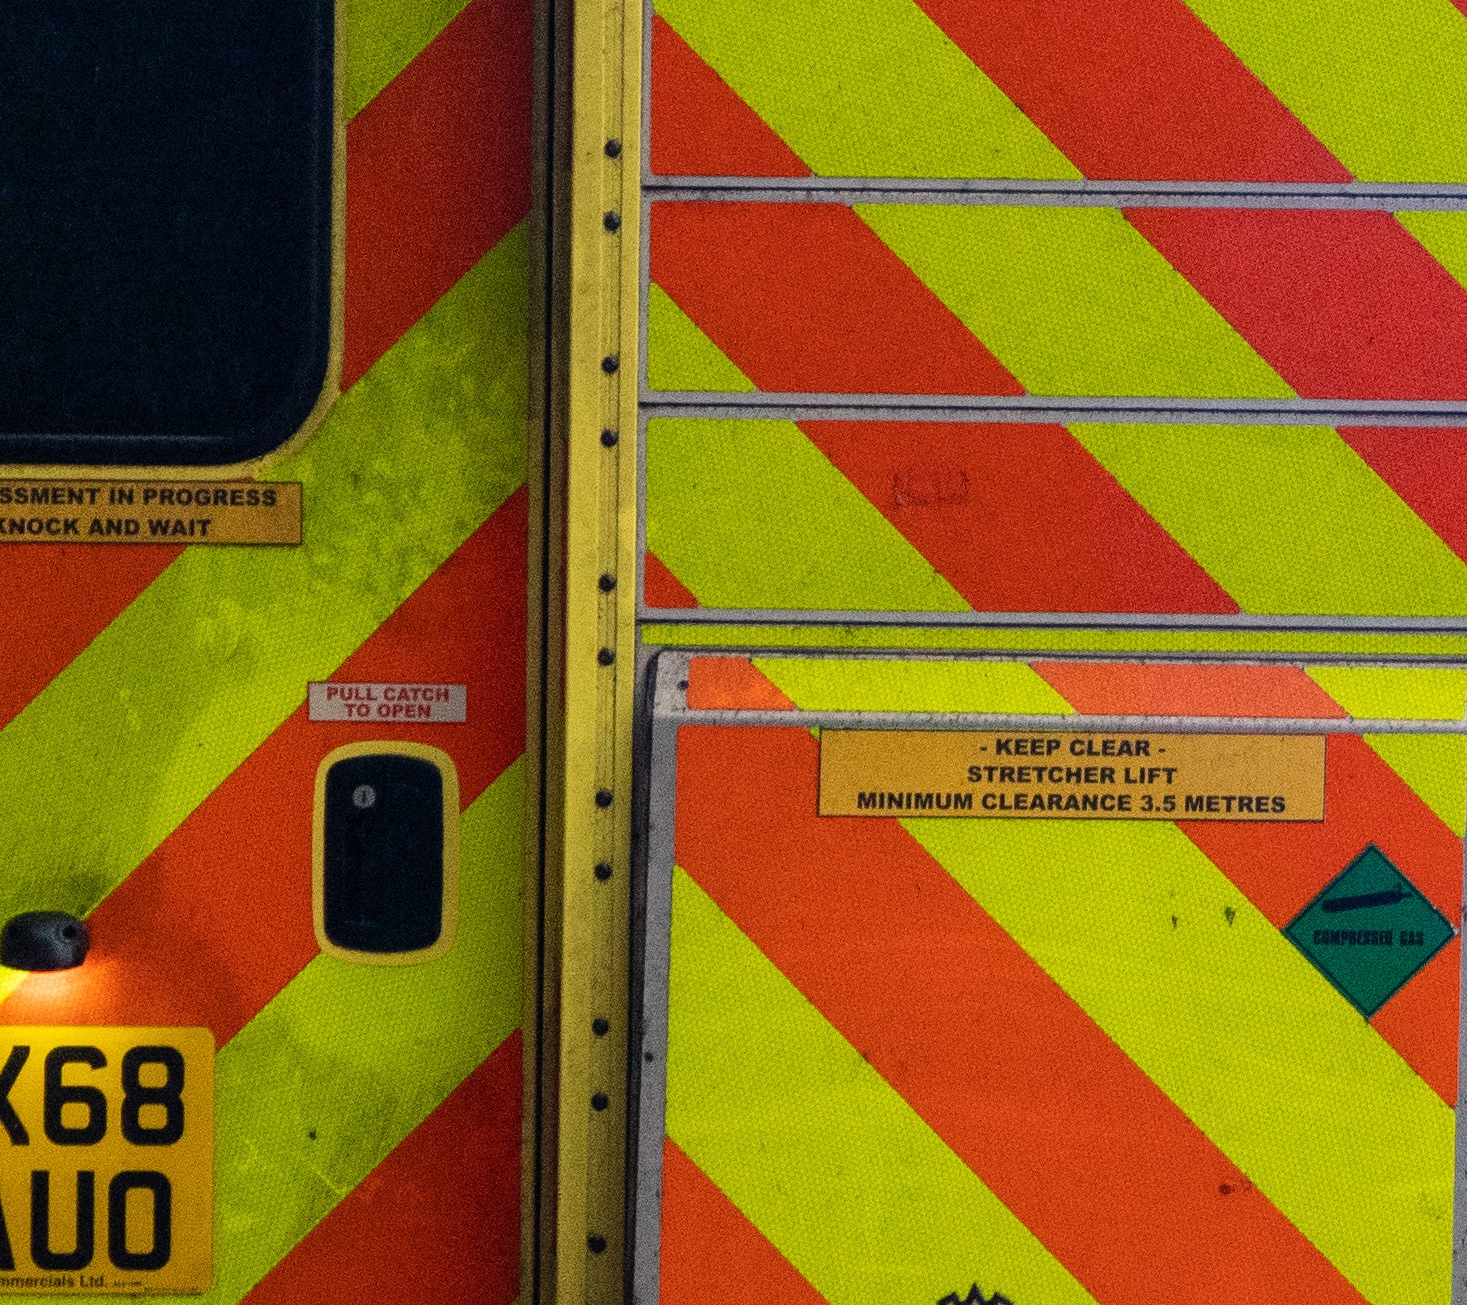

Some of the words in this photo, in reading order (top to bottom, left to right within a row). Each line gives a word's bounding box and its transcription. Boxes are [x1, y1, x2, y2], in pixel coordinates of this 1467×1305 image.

[109, 489, 134, 506] IN
[142, 488, 277, 507] PROGRESS
[89, 518, 139, 536] AND
[148, 518, 212, 537] WAIT
[326, 686, 377, 701] PULL
[383, 687, 449, 702] CATCH
[344, 703, 370, 718] TO
[377, 704, 432, 718] OPEN
[996, 739, 1060, 756] KEEP
[1069, 739, 1150, 757] CLEAR
[967, 766, 1115, 784] STRETCHER
[1124, 767, 1178, 785] LIFT
[857, 792, 974, 810] MINIMUM
[981, 794, 1132, 812] CLEARANCE
[1139, 795, 1176, 813] 3.5
[1184, 795, 1286, 814] METRES
[1313, 929, 1393, 946] COMPRESSED
[1400, 930, 1424, 947] GAS
[79, 1274, 106, 1288] Ltd.
